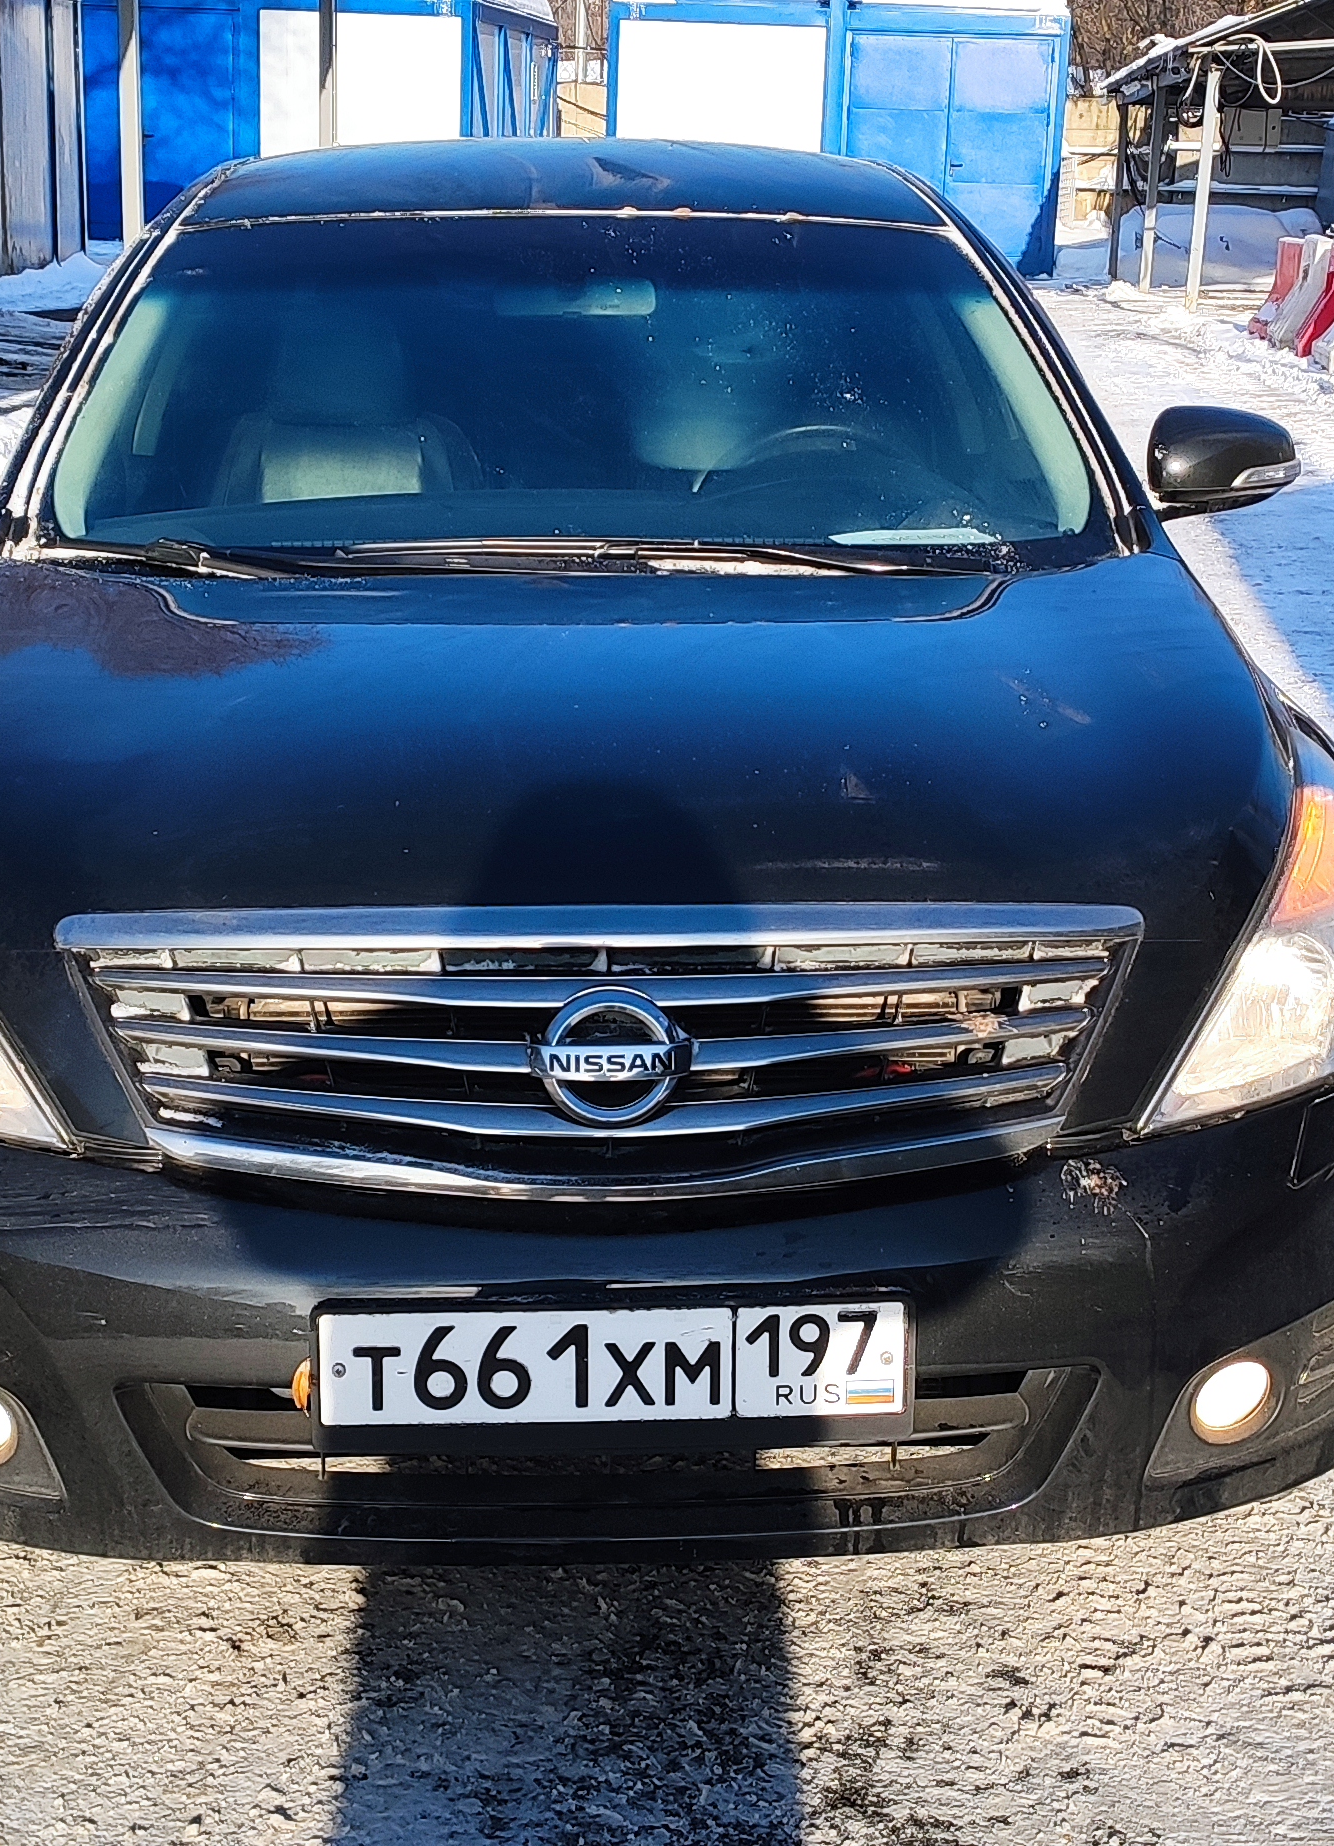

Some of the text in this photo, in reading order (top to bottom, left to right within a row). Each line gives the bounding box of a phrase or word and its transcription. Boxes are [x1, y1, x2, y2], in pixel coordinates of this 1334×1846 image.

[548, 1051, 677, 1074] NISSAN
[744, 1310, 879, 1378] 197
[775, 1382, 841, 1407] RUS
